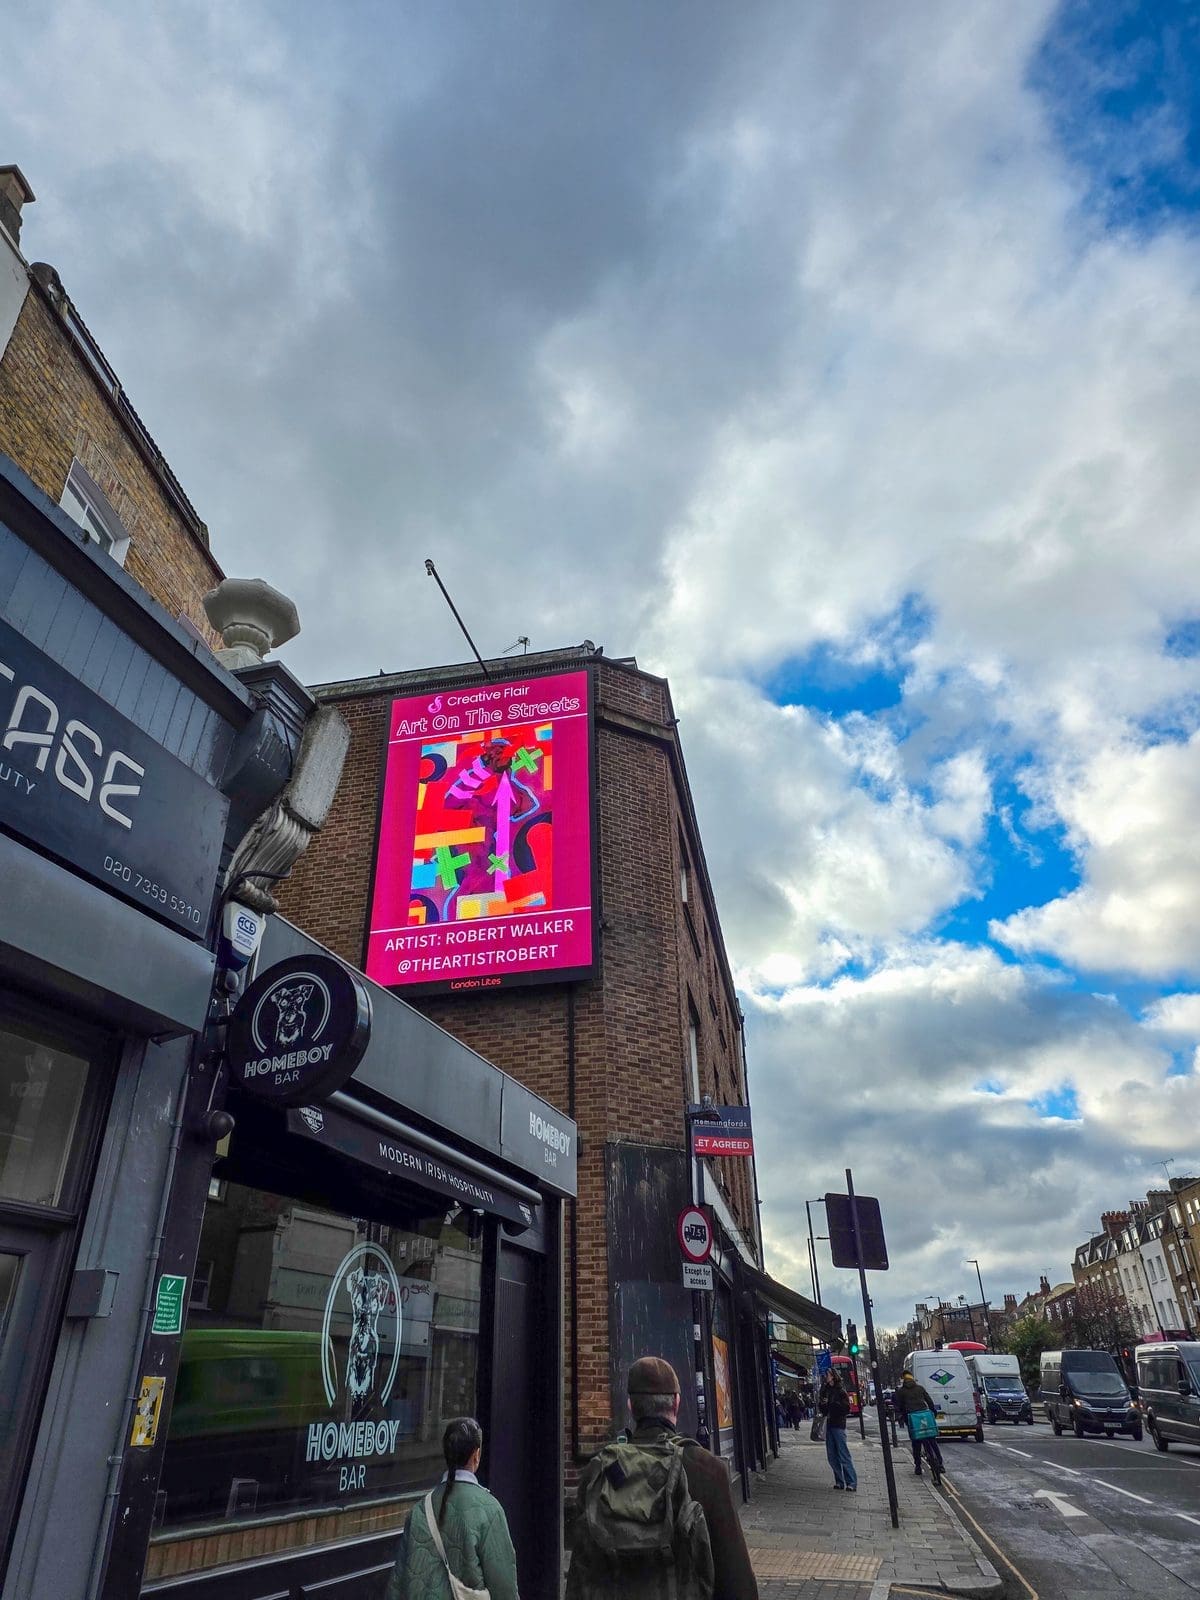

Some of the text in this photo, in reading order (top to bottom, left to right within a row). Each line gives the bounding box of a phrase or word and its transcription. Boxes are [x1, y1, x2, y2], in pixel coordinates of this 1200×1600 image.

[447, 685, 530, 706] Creative Flair
[396, 696, 580, 736] Art On The Streets
[0, 662, 145, 830] ASE
[103, 855, 201, 923] 020 7359 5310
[238, 916, 257, 935] ACE
[385, 919, 575, 952] ARTIST: ROBERT WALKER
[397, 944, 559, 974] @THEARTISTROBERT
[451, 977, 502, 990] London Lites
[244, 1043, 334, 1078] HOMEBOY
[274, 1070, 300, 1085] BAR
[530, 1111, 571, 1157] HOMEBOY
[712, 1140, 750, 1149] AGREED
[544, 1148, 557, 1168] BAR
[379, 1142, 494, 1204] MODERN IRISH HOSPITALITY
[684, 1266, 702, 1276] Except
[690, 1278, 707, 1286] access
[306, 1420, 401, 1462] HOMEBOY
[339, 1465, 366, 1492] BAR
